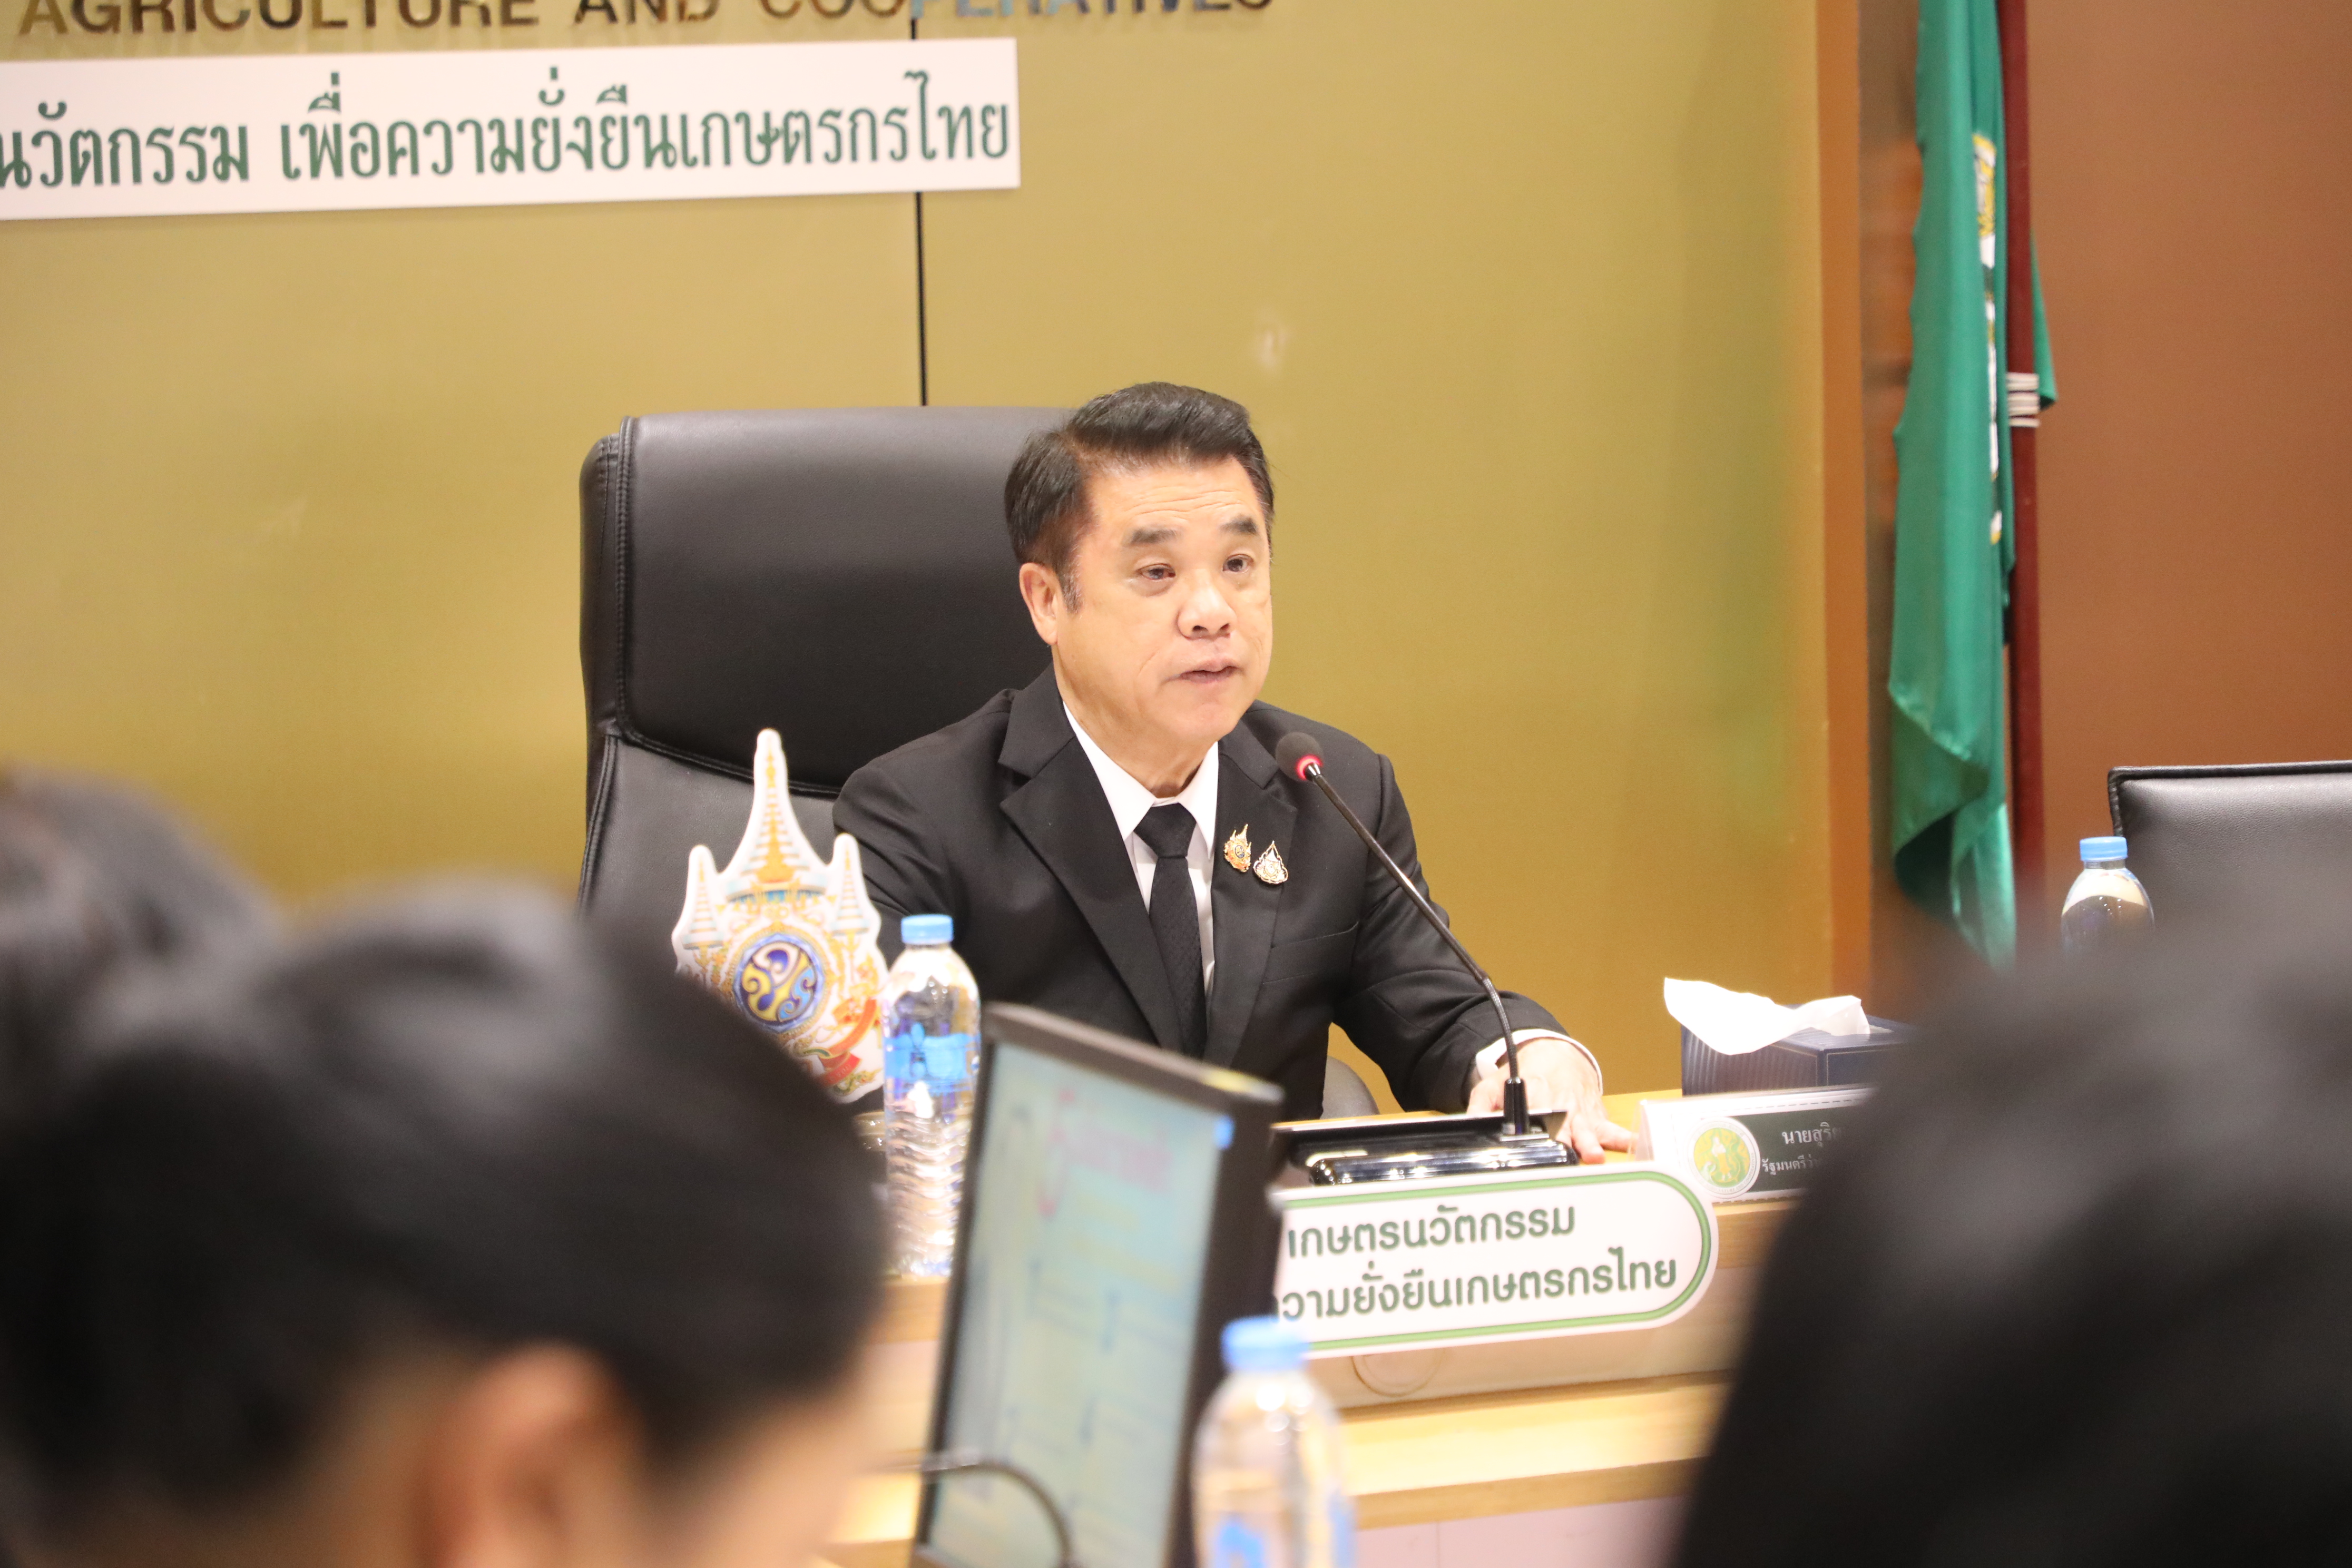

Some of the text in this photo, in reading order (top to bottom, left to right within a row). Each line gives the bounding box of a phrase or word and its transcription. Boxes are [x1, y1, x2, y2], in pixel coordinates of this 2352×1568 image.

[280, 66, 1009, 180] เพื่อความยั่งยืนเกษตรกรไทย
[1287, 1204, 1576, 1258] เกษตรนวัตกรรม
[1274, 1247, 1678, 1322] วามยั่งยืนเกษตรกรไทย
